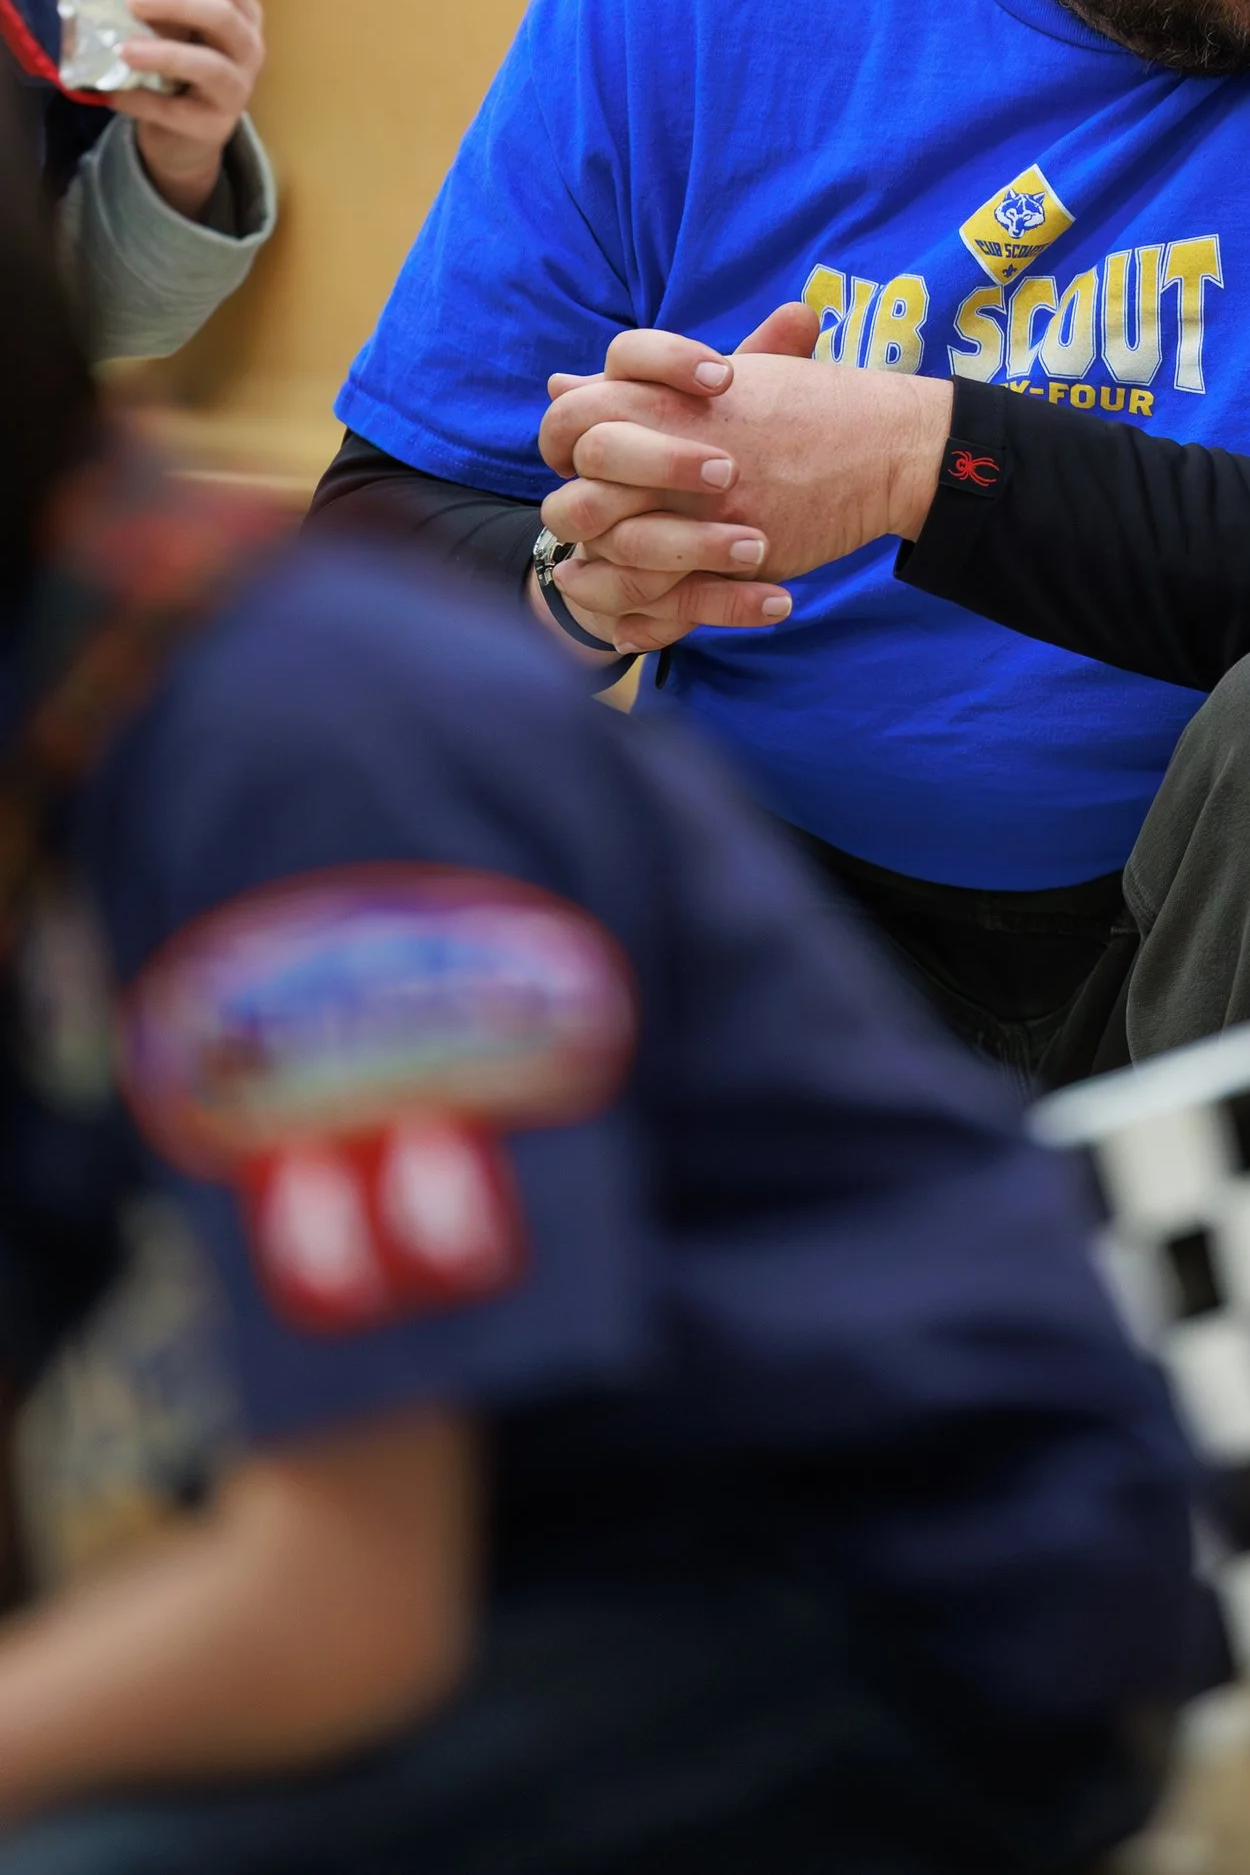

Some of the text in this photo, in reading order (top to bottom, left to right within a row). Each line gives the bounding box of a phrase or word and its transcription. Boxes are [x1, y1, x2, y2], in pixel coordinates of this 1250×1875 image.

[974, 238, 1003, 257] CUB
[801, 234, 1224, 394] CUB SCOUT
[998, 380, 1153, 417] Y-FOUR
